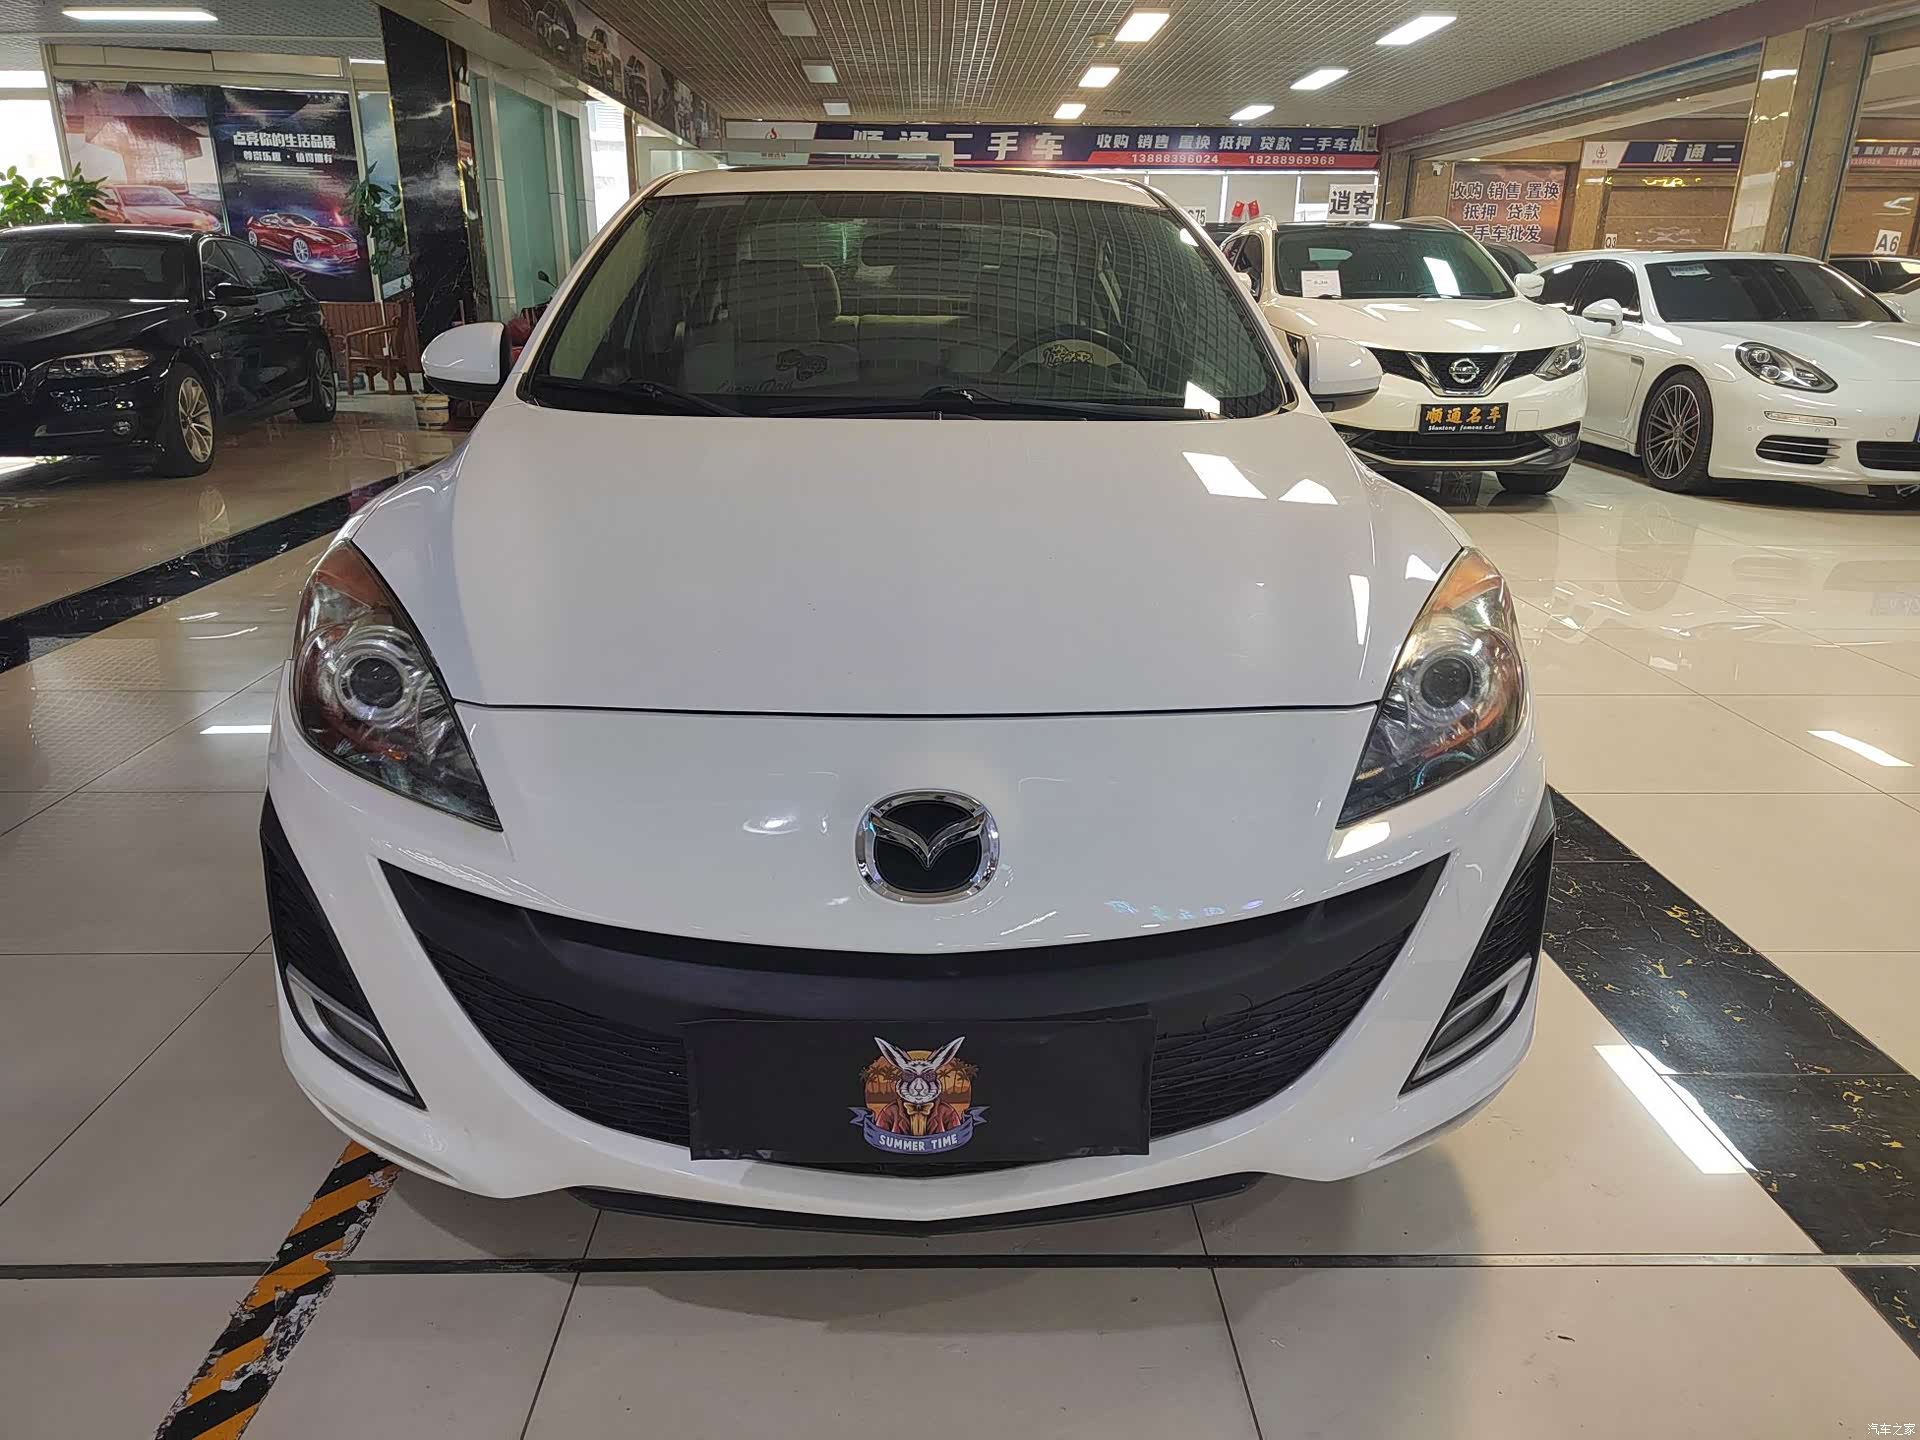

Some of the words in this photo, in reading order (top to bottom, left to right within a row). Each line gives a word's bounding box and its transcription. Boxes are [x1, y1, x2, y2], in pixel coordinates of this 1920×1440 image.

[233, 131, 337, 149] 点亮你的生活品质
[1097, 134, 1129, 149] 收购
[1137, 134, 1169, 149] 销售
[1178, 135, 1211, 150] 置换
[1219, 135, 1252, 150] 抵押
[1259, 136, 1293, 151] 贷款
[1131, 154, 1219, 164] 13888396024
[1248, 155, 1336, 165] 18288969968
[1653, 143, 1736, 163] 顺通二
[1451, 182, 1483, 200] 收购
[1487, 182, 1521, 200] 销售
[1525, 182, 1560, 200] 置换
[1329, 190, 1375, 216] 逍客
[1463, 203, 1498, 220] 抵押
[1506, 203, 1541, 220] 贷款
[1876, 233, 1900, 252] A6
[1425, 406, 1502, 424] 顺通名车
[879, 1135, 925, 1151] SUMMER
[931, 1134, 958, 1150] TIME
